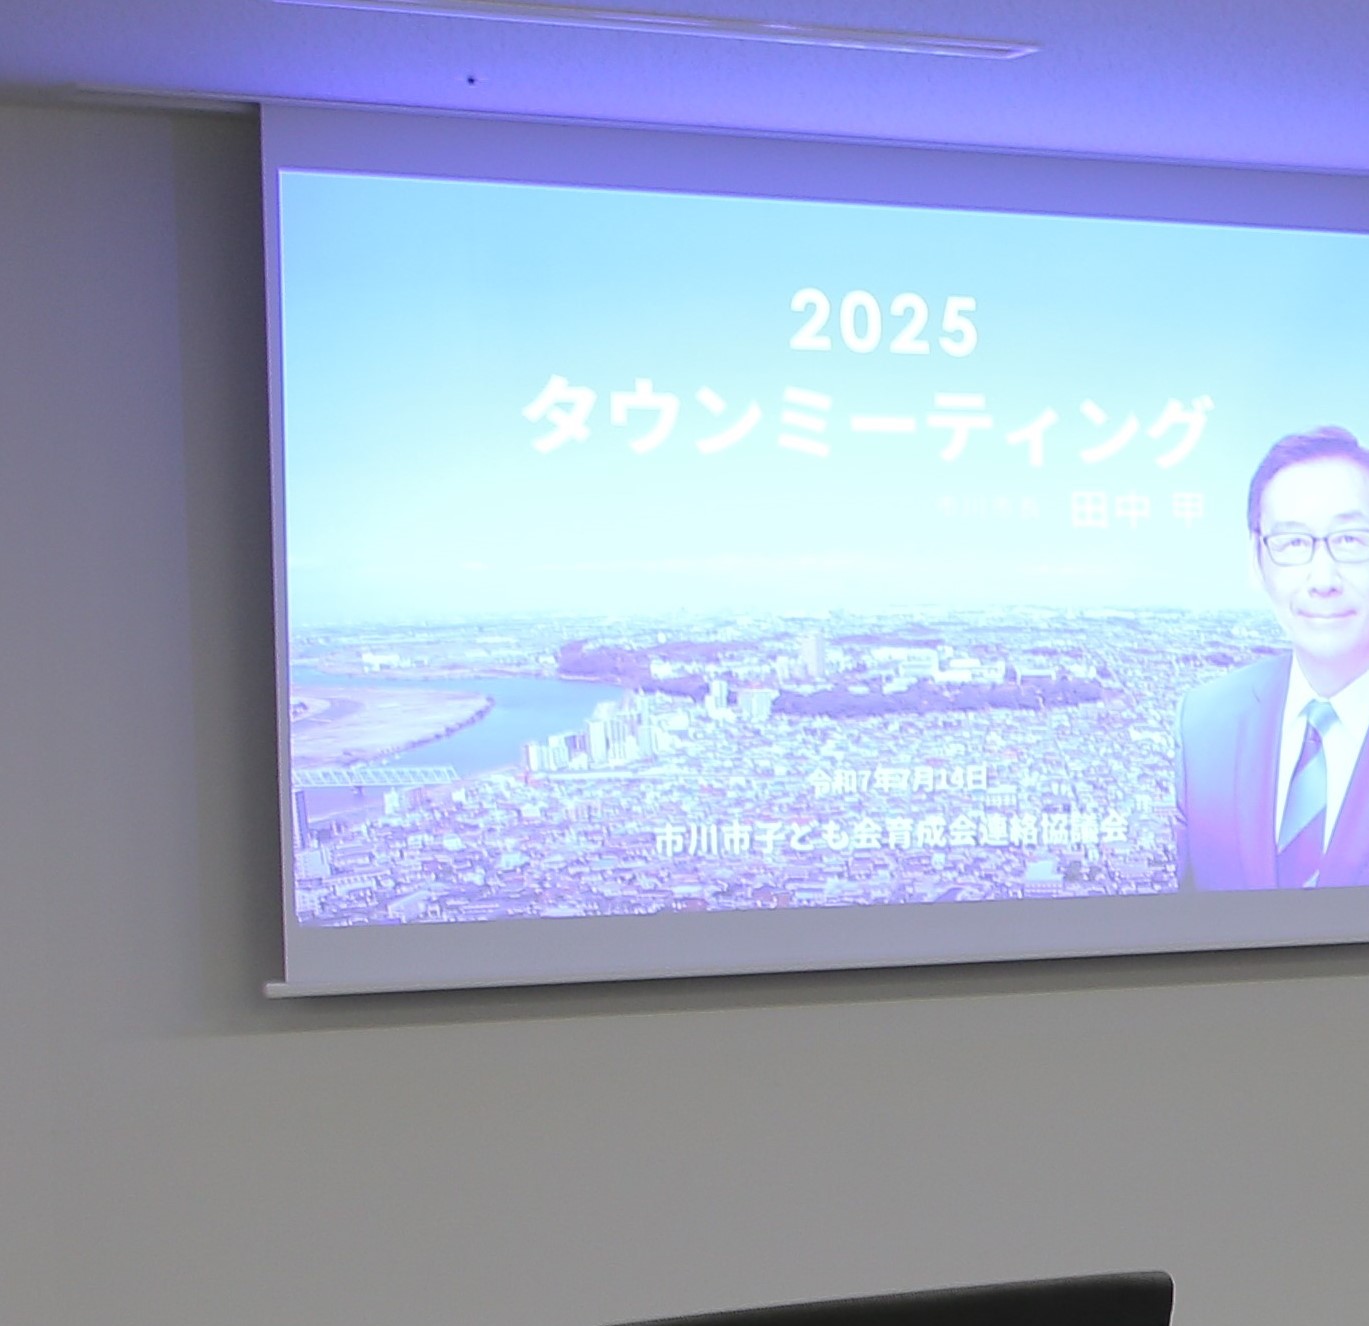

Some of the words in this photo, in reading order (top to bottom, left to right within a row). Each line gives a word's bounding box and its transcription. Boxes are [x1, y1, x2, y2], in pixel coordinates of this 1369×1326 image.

[789, 287, 979, 357] 2025
[522, 373, 1215, 470] タウンミーティング
[1070, 489, 1151, 529] 田中
[653, 808, 1129, 856] 市川市子ども会育成会連絡協議会
